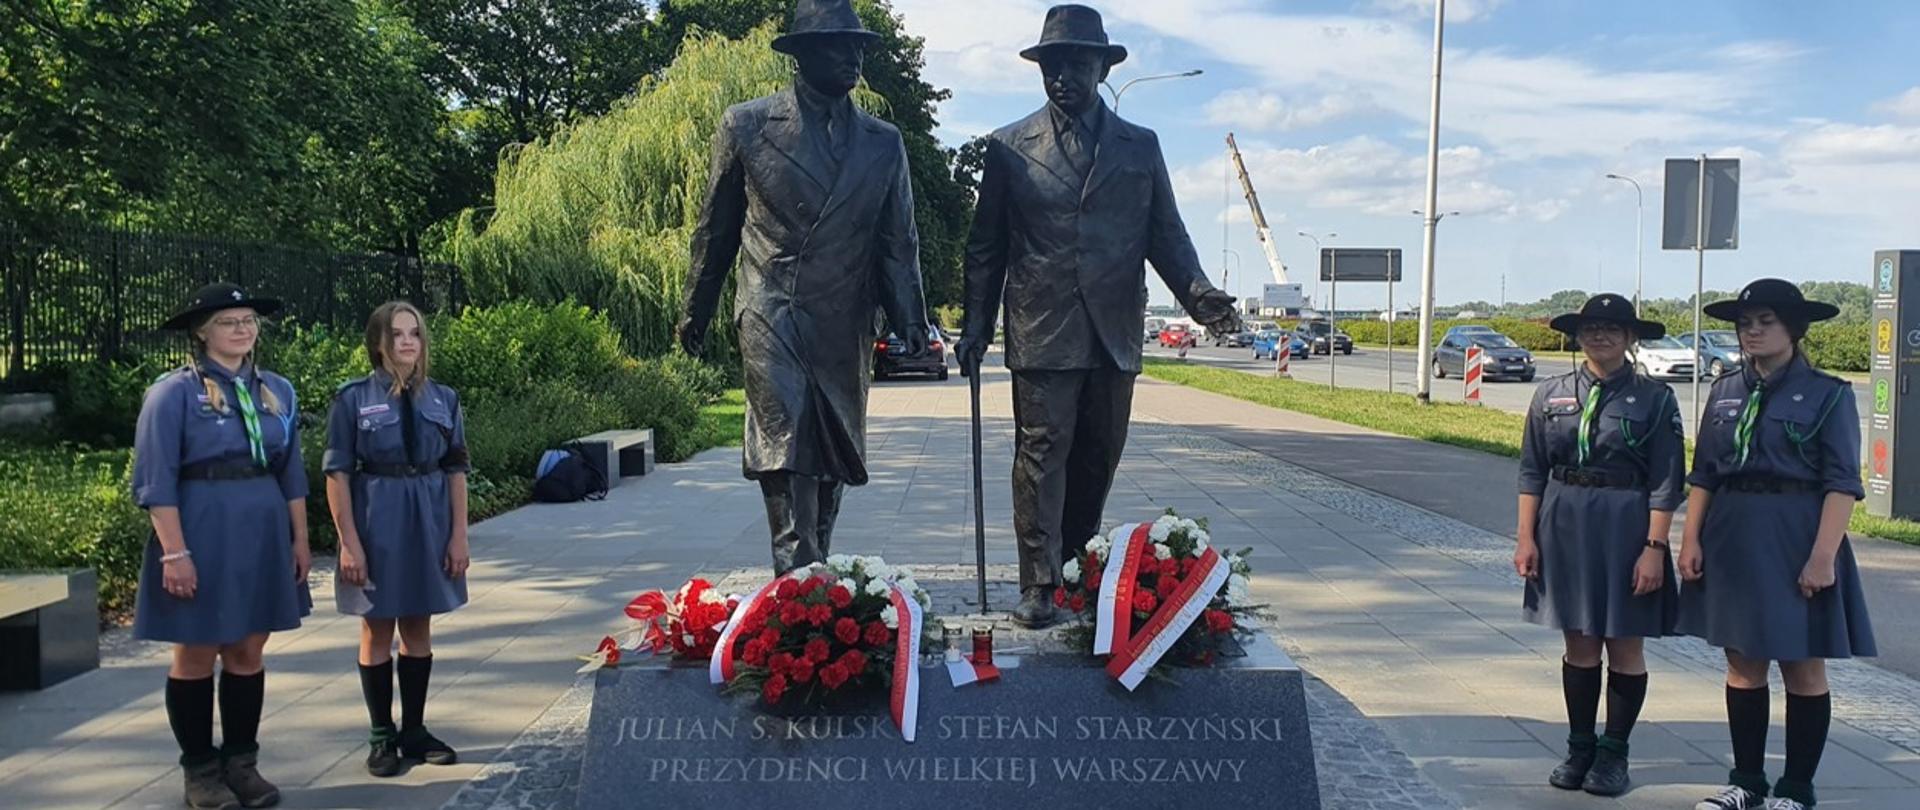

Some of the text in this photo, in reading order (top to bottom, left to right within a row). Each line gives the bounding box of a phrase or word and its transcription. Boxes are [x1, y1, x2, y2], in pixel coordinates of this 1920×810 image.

[615, 713, 1284, 746] JULIAN S. KULSK STEFAN STARZYŃSKI
[649, 757, 1246, 788] PREZYDENCI WIELKIEJ WARSZAWY
